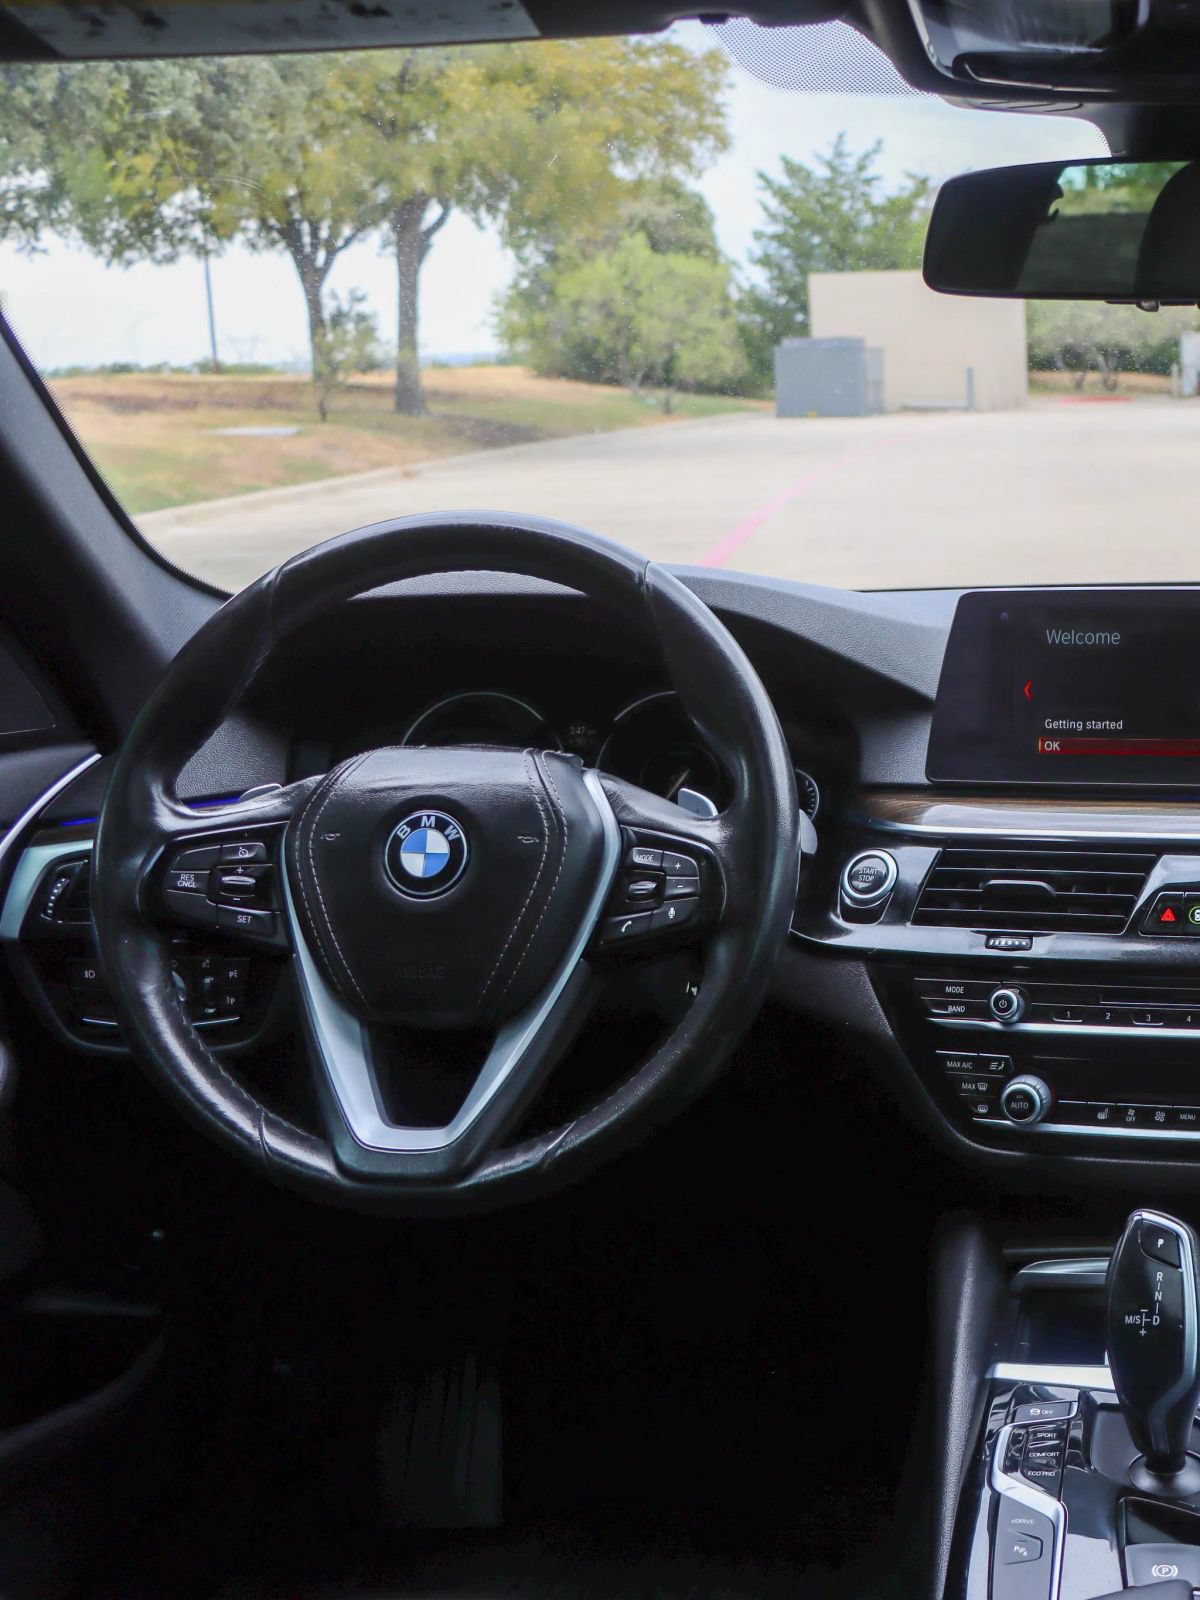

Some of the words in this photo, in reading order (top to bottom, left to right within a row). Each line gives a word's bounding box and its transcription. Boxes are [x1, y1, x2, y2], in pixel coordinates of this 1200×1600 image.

[1046, 629, 1121, 645] Welcome
[1044, 718, 1083, 731] Getting
[1086, 719, 1123, 730] started
[1044, 741, 1060, 751] OK
[396, 815, 461, 841] BMW
[634, 854, 655, 862] MODE
[858, 874, 875, 882] STOP
[177, 880, 197, 888] CNCL
[237, 915, 252, 924] SET
[945, 986, 965, 994] MODE
[947, 1005, 966, 1013] BAND
[1066, 1011, 1071, 1019] 1
[1105, 1012, 1111, 1020] 2
[1146, 1014, 1151, 1022] 3
[1186, 1015, 1192, 1023] 4
[946, 1061, 961, 1069] MAX
[961, 1062, 973, 1070] A/C
[961, 1082, 976, 1090] MAX
[1010, 1101, 1029, 1110] AUTO
[1179, 1113, 1196, 1121] MENU
[1157, 1238, 1165, 1249] P
[1156, 1271, 1163, 1282] R
[1154, 1291, 1162, 1301] N
[1124, 1315, 1141, 1325] M/S
[1152, 1315, 1160, 1325] D
[1028, 1451, 1061, 1459] COMFORT
